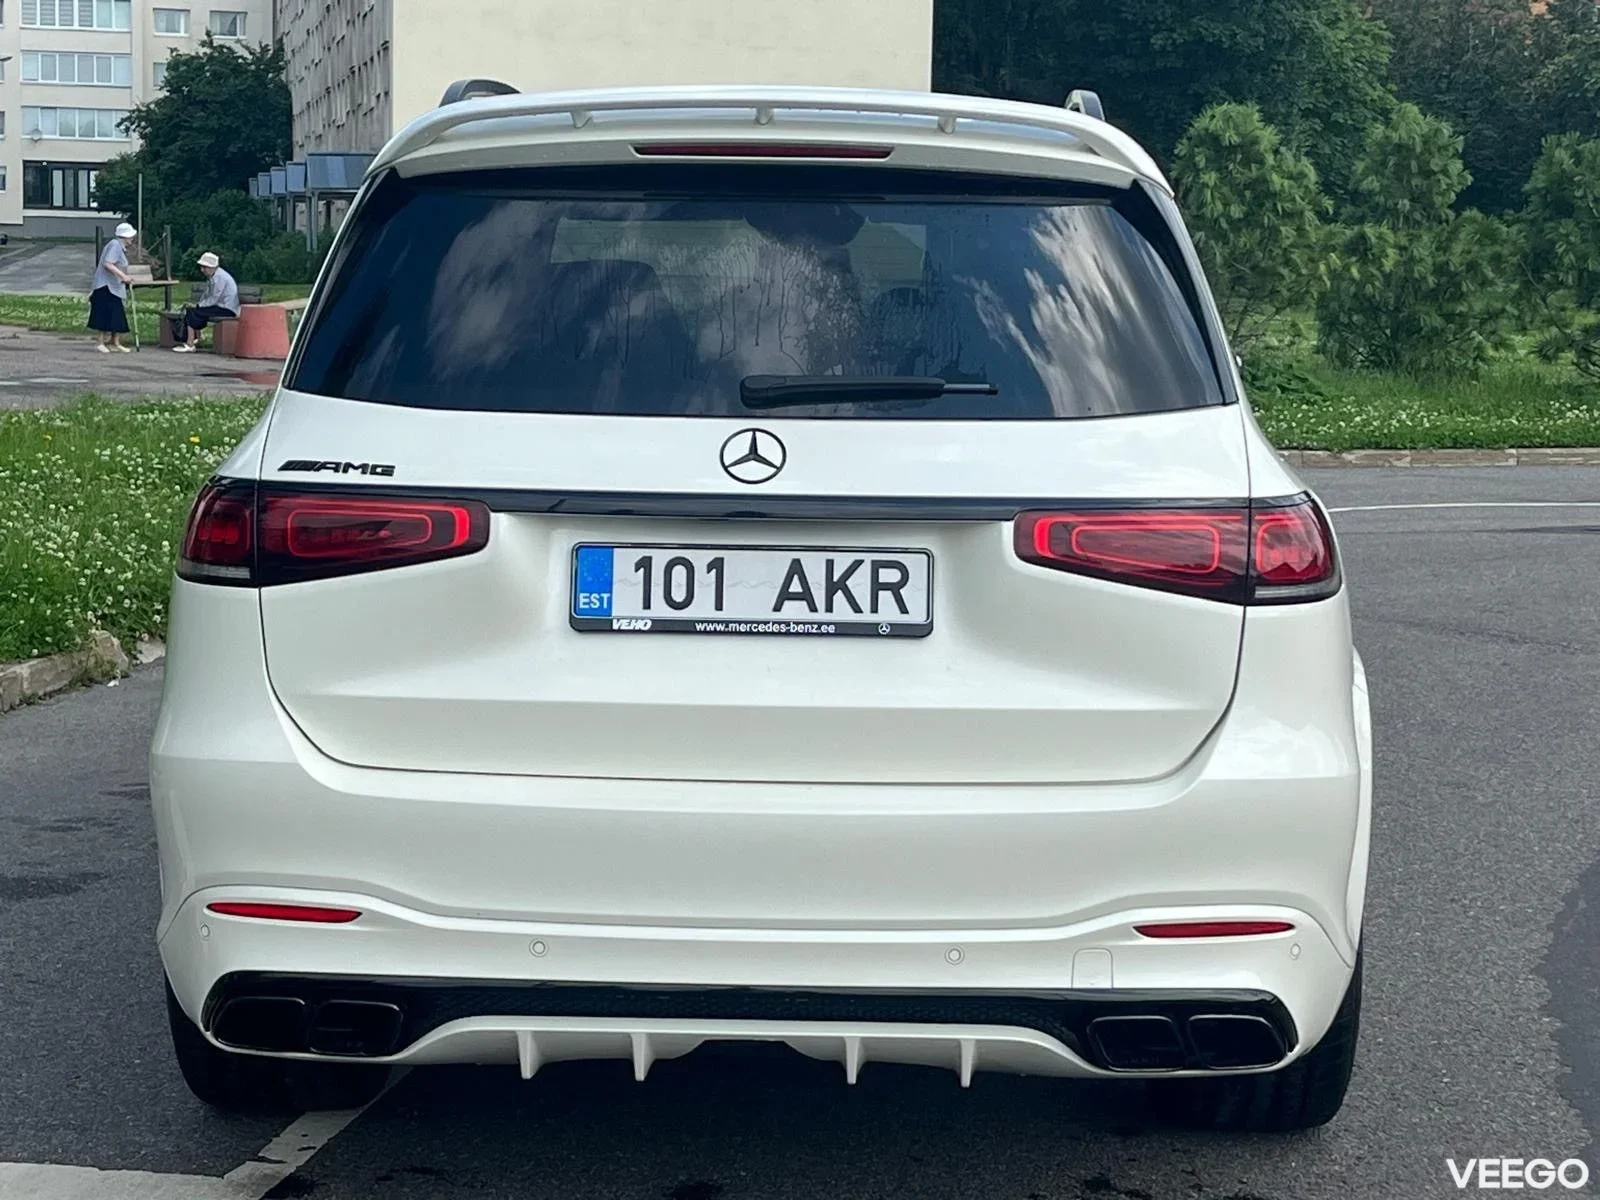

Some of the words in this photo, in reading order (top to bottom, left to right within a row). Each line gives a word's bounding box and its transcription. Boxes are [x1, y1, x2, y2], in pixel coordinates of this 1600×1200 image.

[316, 460, 396, 477] AMG
[633, 555, 726, 612] 101
[771, 557, 910, 615] AKR
[578, 593, 612, 609] EST
[611, 618, 652, 631] VEHO
[694, 620, 836, 634] www.mercedes-benz.ee
